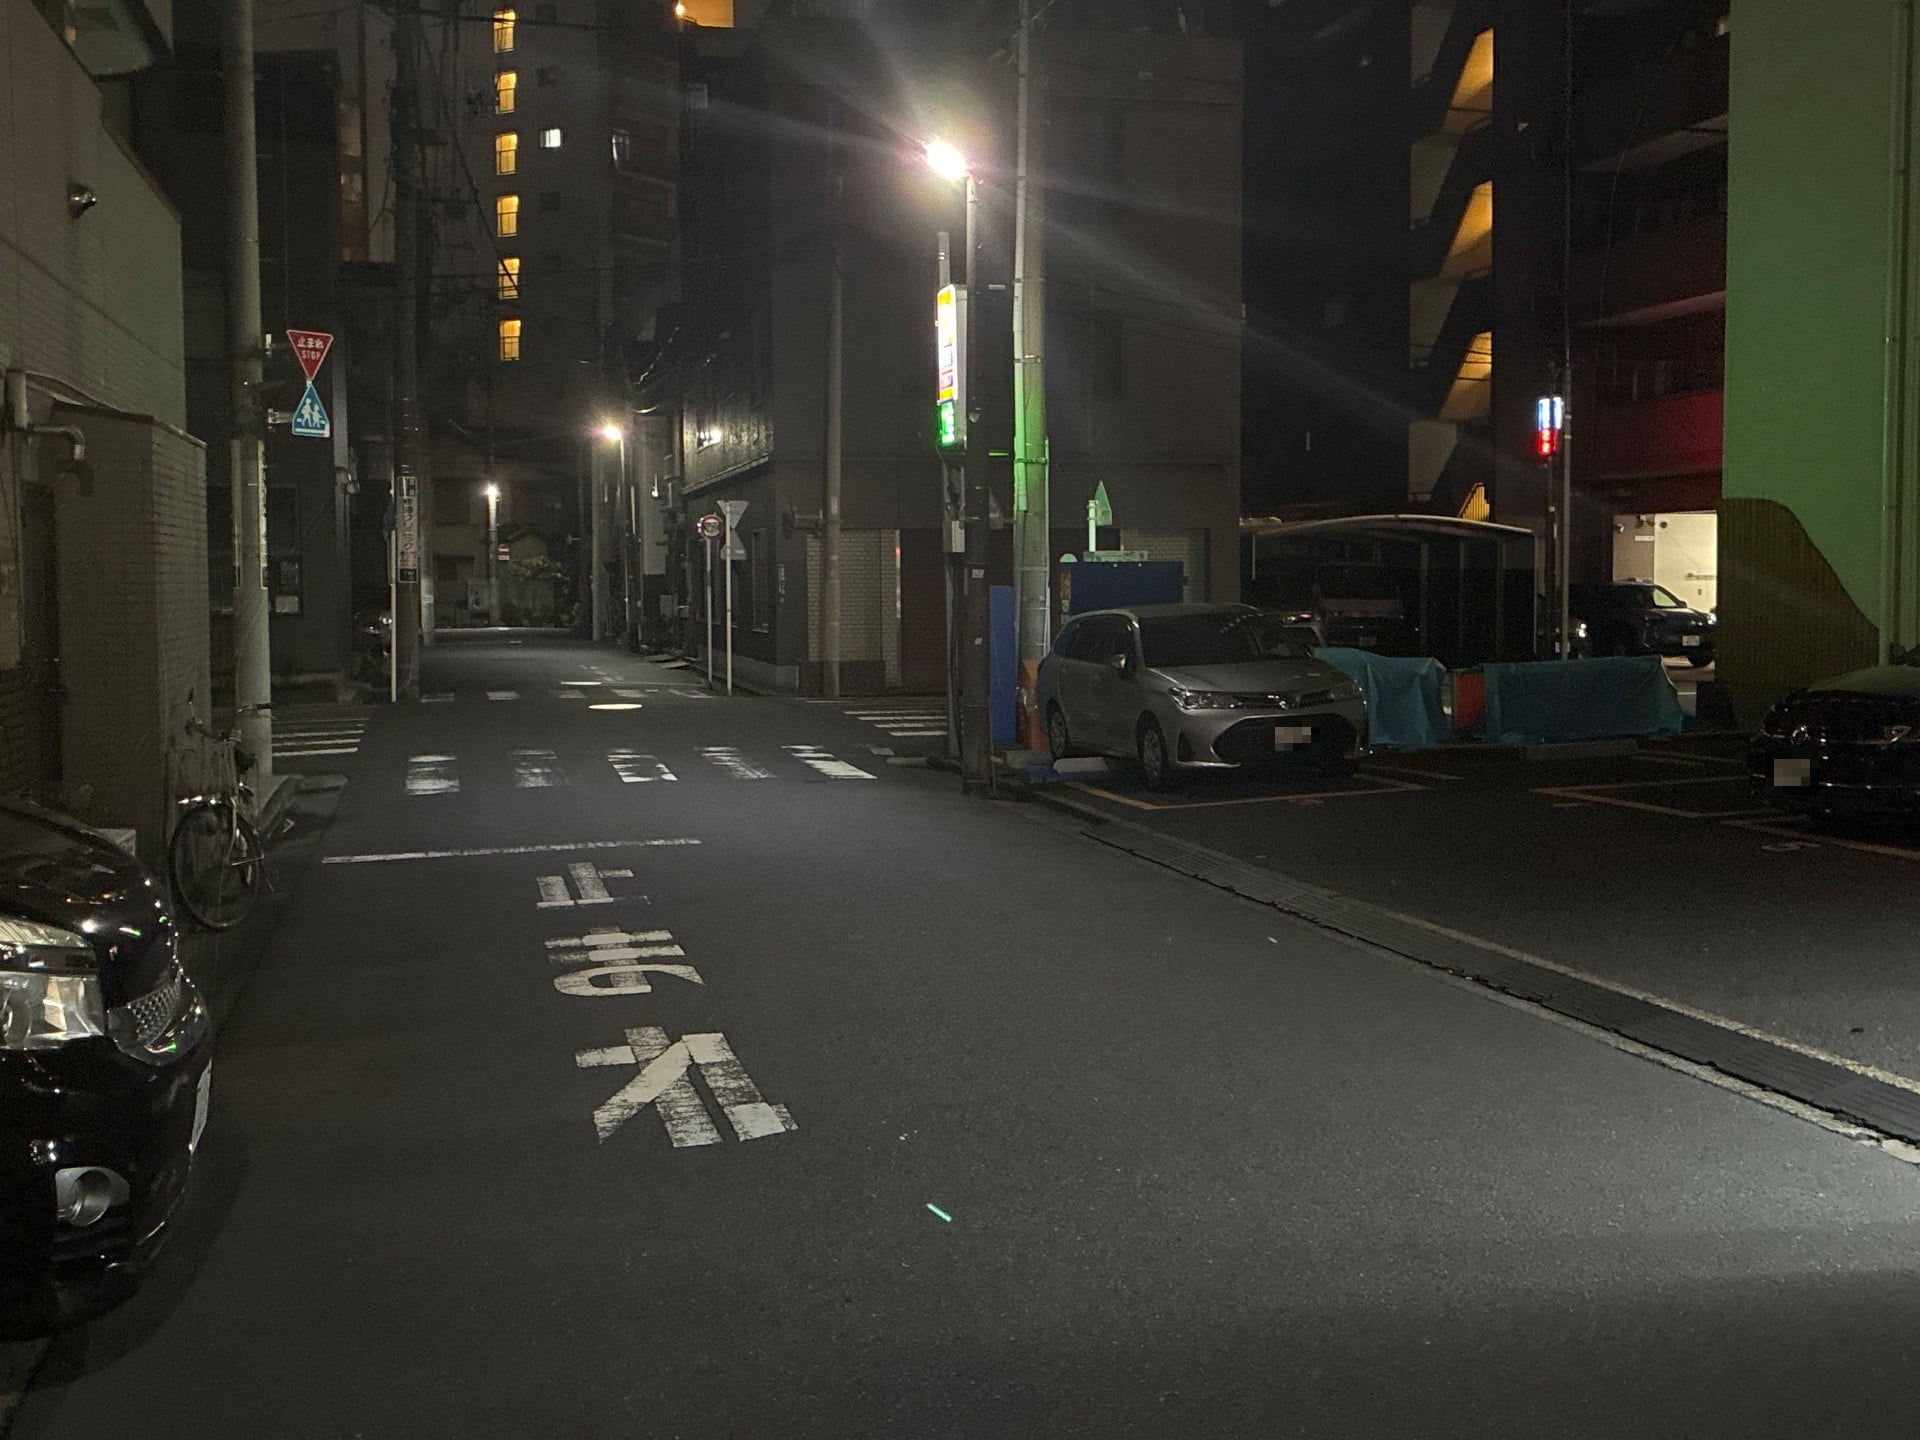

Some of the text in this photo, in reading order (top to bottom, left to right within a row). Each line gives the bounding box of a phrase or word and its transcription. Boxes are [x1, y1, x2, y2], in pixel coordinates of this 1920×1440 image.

[297, 336, 324, 349] 止まれ
[301, 350, 321, 360] STOP
[536, 862, 799, 1148] 止まれ
